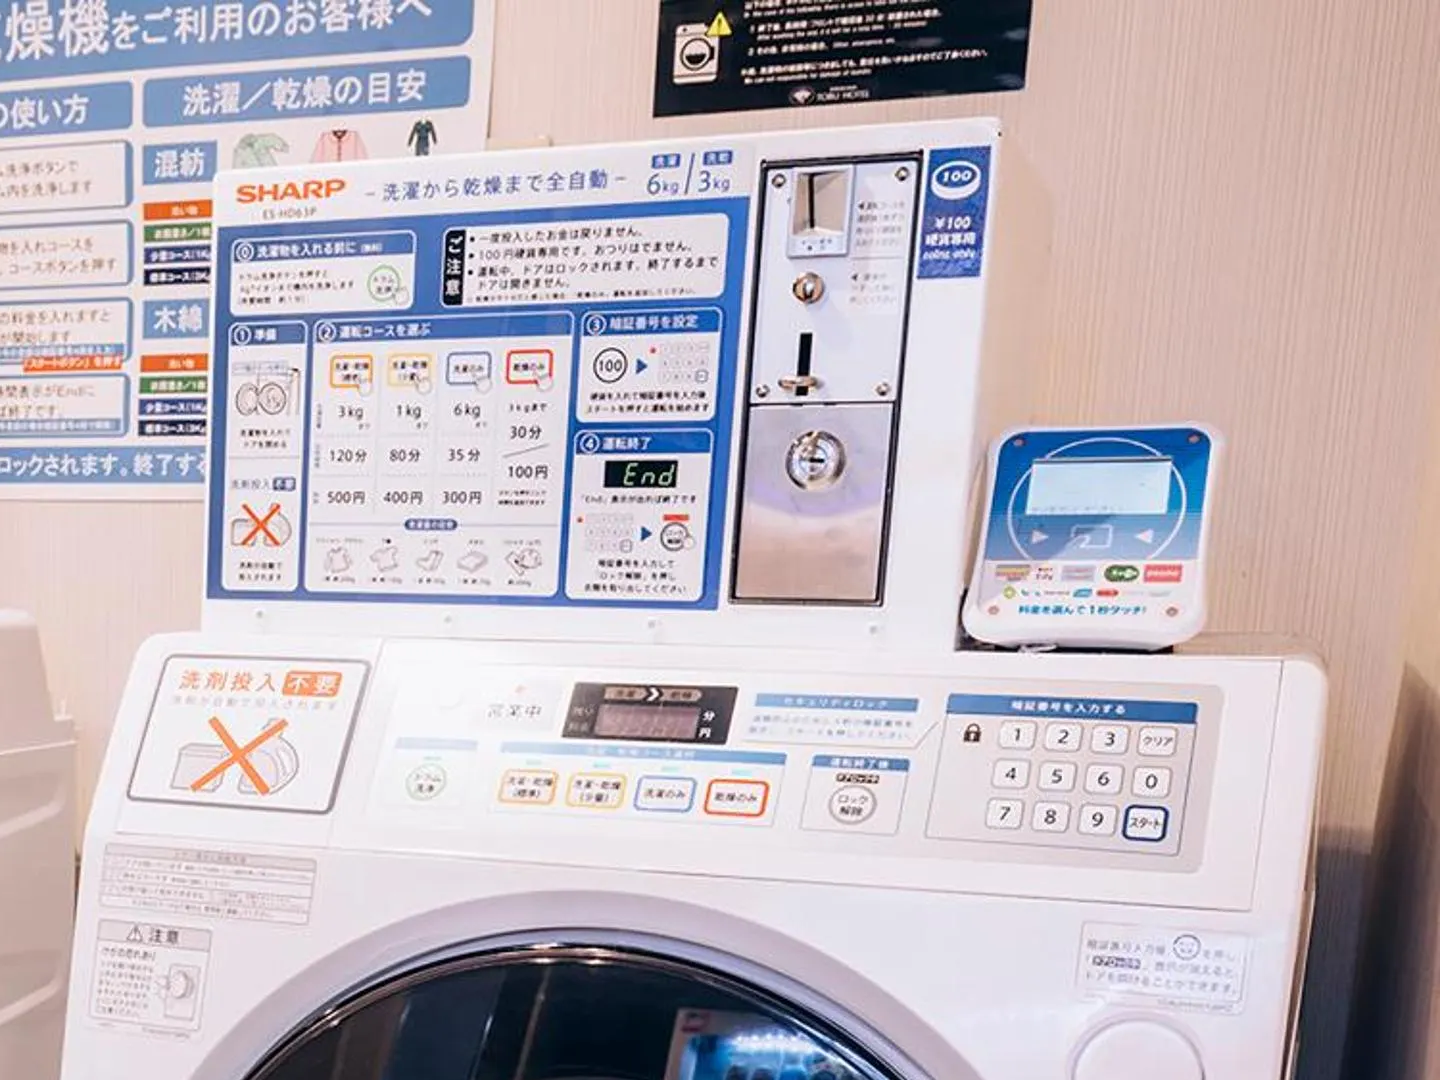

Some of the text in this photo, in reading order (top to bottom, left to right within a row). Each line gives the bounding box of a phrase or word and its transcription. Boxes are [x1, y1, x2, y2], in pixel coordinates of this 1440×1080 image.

[154, 148, 206, 178] 混紡
[942, 169, 972, 183] 100
[236, 179, 346, 204] SHARP
[153, 304, 203, 333] 木綿
[598, 359, 623, 372] 100
[329, 448, 481, 463] 120分 80分 35分
[508, 465, 549, 480] 100円
[623, 462, 676, 487] End
[327, 491, 366, 505] 500円
[383, 491, 424, 505] 400円
[441, 491, 483, 505] 300円
[178, 669, 340, 696] 洗剤投入 不要
[1011, 701, 1127, 716] 暗証番号を入力する
[1014, 728, 1022, 742] 1
[1057, 730, 1069, 744] 2
[1104, 732, 1116, 747] 3
[1005, 767, 1158, 790] 4 5 6 0
[999, 806, 1011, 821] 7
[1044, 808, 1057, 825] 8
[1091, 811, 1104, 828] 9
